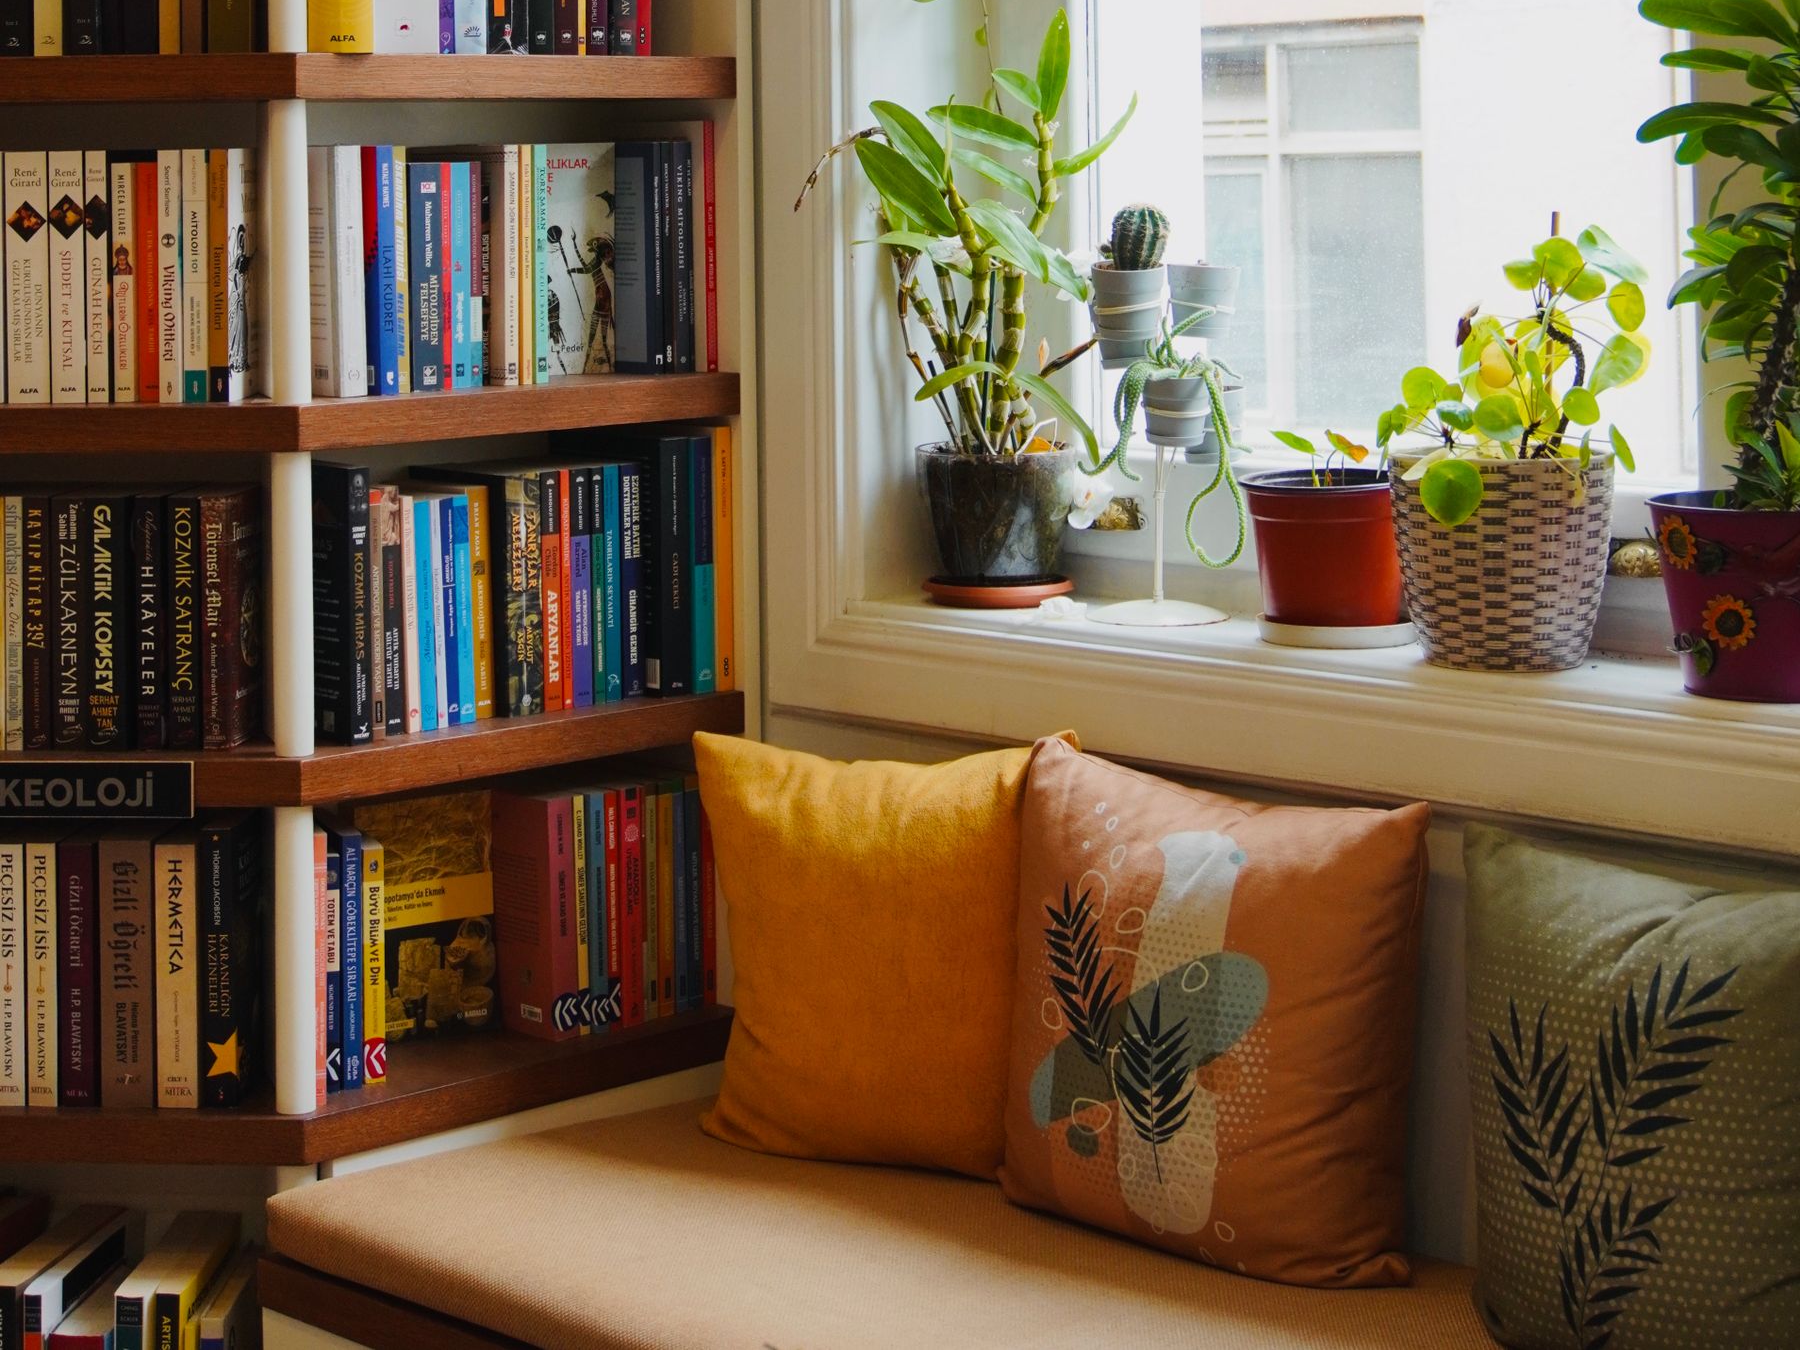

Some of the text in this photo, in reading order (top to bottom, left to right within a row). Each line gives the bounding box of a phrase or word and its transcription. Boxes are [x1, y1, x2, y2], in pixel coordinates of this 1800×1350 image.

[10, 177, 42, 188] Girard
[14, 168, 38, 177] René
[51, 178, 81, 188] Girard
[54, 168, 77, 178] René
[117, 174, 126, 236] MIRCEA ELIADE
[190, 210, 200, 256] MİTOLOJİ
[676, 164, 686, 268] VİKİNG MİTOLOJİSİ
[58, 250, 72, 371] ŞİDDET ve KUTSAL
[91, 257, 103, 354] GÜNAH KEÇİSİ
[162, 264, 175, 309] Viking
[382, 245, 394, 334] İLAHİ KUDRET
[420, 283, 430, 341] FELSEFEYE
[429, 274, 440, 346] MİTOLOJİDEN
[26, 509, 44, 649] KAYIP KİTAP 397
[93, 505, 112, 601] GALAKTİK
[606, 530, 616, 628] TANRILARIN SEYAHATİ
[671, 553, 681, 610] CADI ÇEKİCİ
[60, 544, 80, 695] ZÜLKARNEYN
[140, 566, 157, 696] HİKÂYELER
[172, 507, 195, 691] KOZMİK SATRANÇ
[354, 552, 366, 660] KOZMİK MİRAS
[629, 590, 638, 665] CİHANGİR GENER
[548, 590, 559, 682] ARYANLAR
[90, 696, 120, 706] SERHAT
[92, 706, 118, 717] AHMET
[97, 718, 114, 729] TAN
[0, 771, 154, 807] KEOLOJİ
[34, 856, 46, 960] PEÇESİZ İSİS
[344, 848, 356, 896] ALİ NARÇIN
[70, 876, 84, 968] GİZLİ ÖĞRETİ
[168, 860, 182, 975] HERMETICA
[328, 898, 336, 926] TOTEM
[328, 928, 335, 940] VE
[369, 886, 381, 986] BÜYÜ BİLİM VE DİN
[346, 900, 357, 1002] GÖBEKLİTEPE SIRLARI
[72, 1011, 81, 1072] BLAVATSKY
